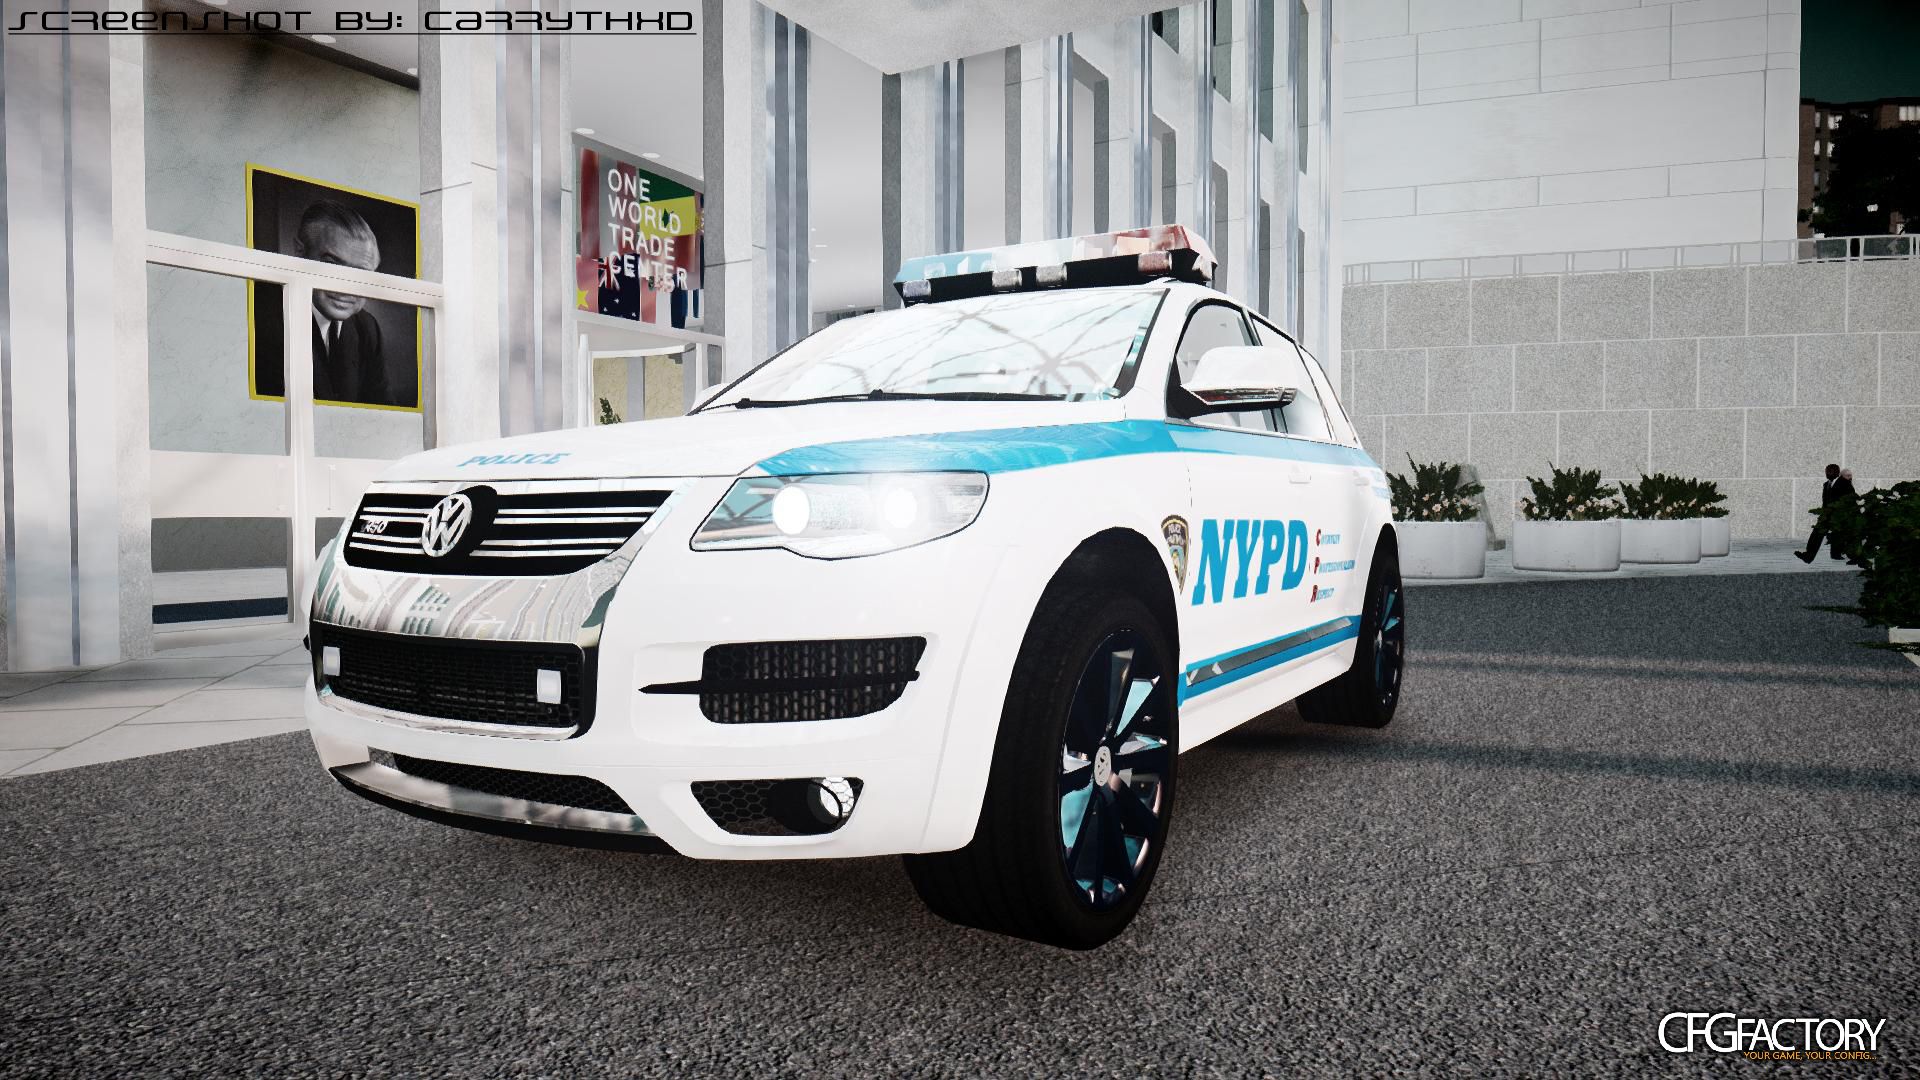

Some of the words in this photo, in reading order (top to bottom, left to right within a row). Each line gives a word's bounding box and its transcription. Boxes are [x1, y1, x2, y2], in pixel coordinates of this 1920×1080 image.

[608, 168, 650, 202] ONE
[608, 194, 681, 234] WORLD
[608, 223, 675, 261] TRADE
[608, 251, 688, 291] CENTER
[458, 453, 571, 467] POLICE
[1191, 519, 1308, 606] NYPD
